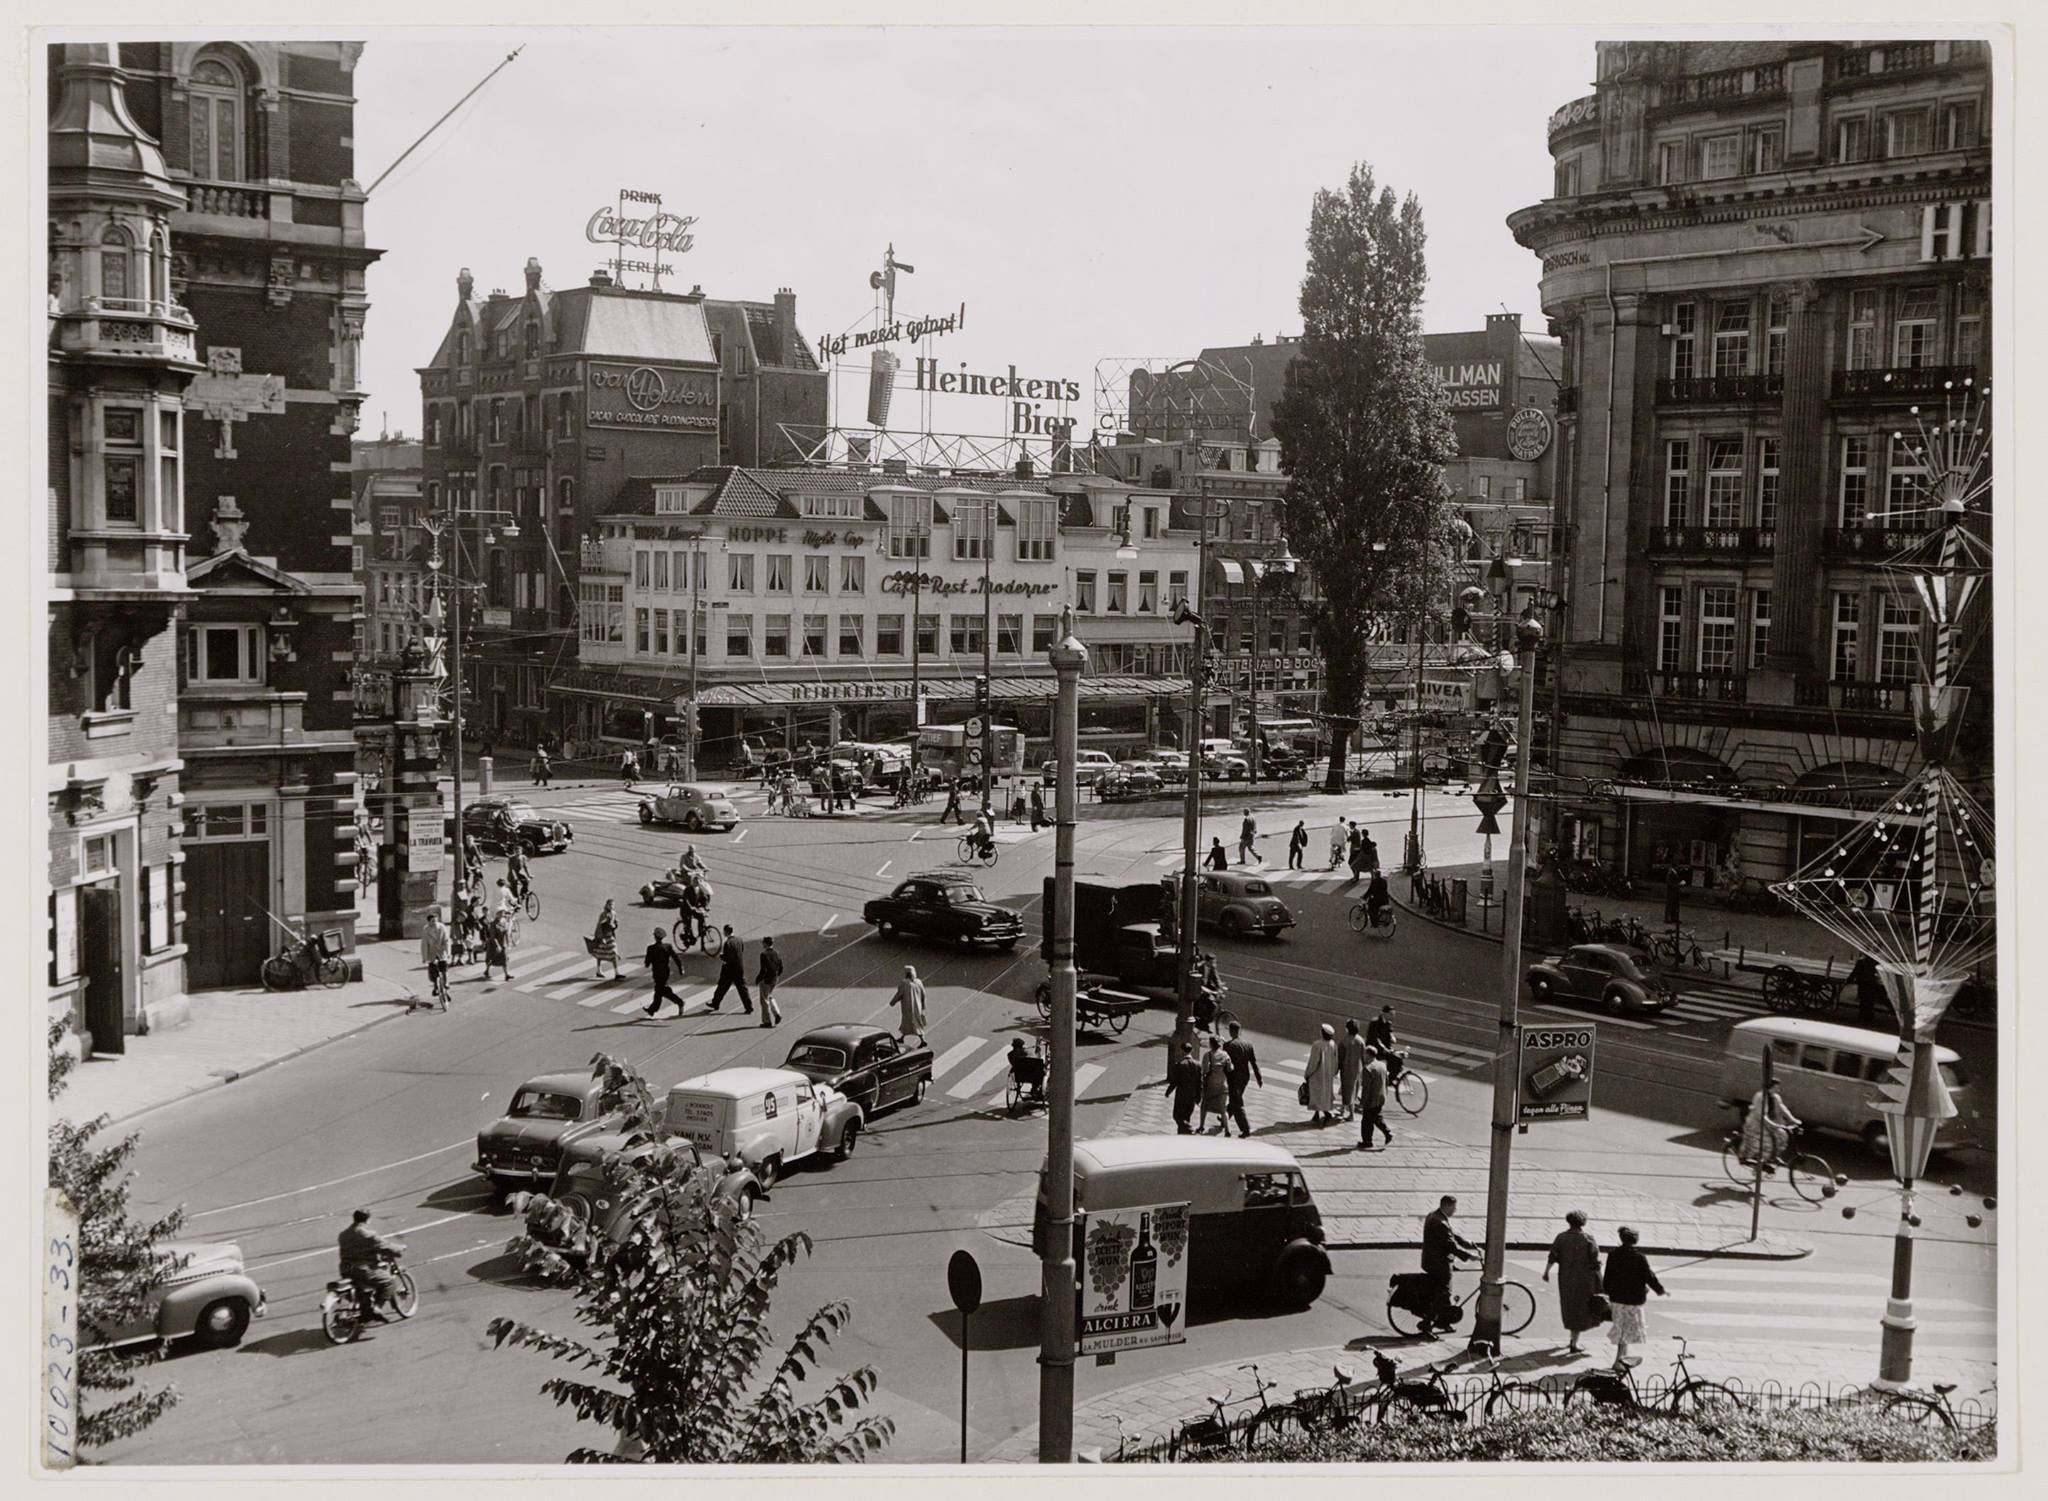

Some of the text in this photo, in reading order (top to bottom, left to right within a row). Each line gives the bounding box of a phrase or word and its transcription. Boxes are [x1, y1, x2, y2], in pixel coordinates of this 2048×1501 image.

[620, 189, 662, 204] DRINK
[818, 333, 848, 362] Het
[855, 320, 902, 347] meest
[915, 357, 1080, 401] Heineken's
[1433, 363, 1500, 387] LLMAN
[632, 371, 714, 406] Houten
[1440, 388, 1499, 407] RASSEN
[616, 412, 660, 425] CHOCOLADE
[1012, 402, 1077, 436] Bier
[1510, 410, 1547, 429] PULLMAN
[728, 526, 865, 549] HOPPE Night Cap
[1274, 658, 1293, 670] DE
[893, 684, 930, 698] BIR
[1416, 682, 1463, 698] NIVEA
[765, 1098, 775, 1113] 95
[1094, 1299, 1119, 1313] drink
[1083, 1313, 1152, 1333] ALCIERA
[1093, 1336, 1138, 1350] MULDER
